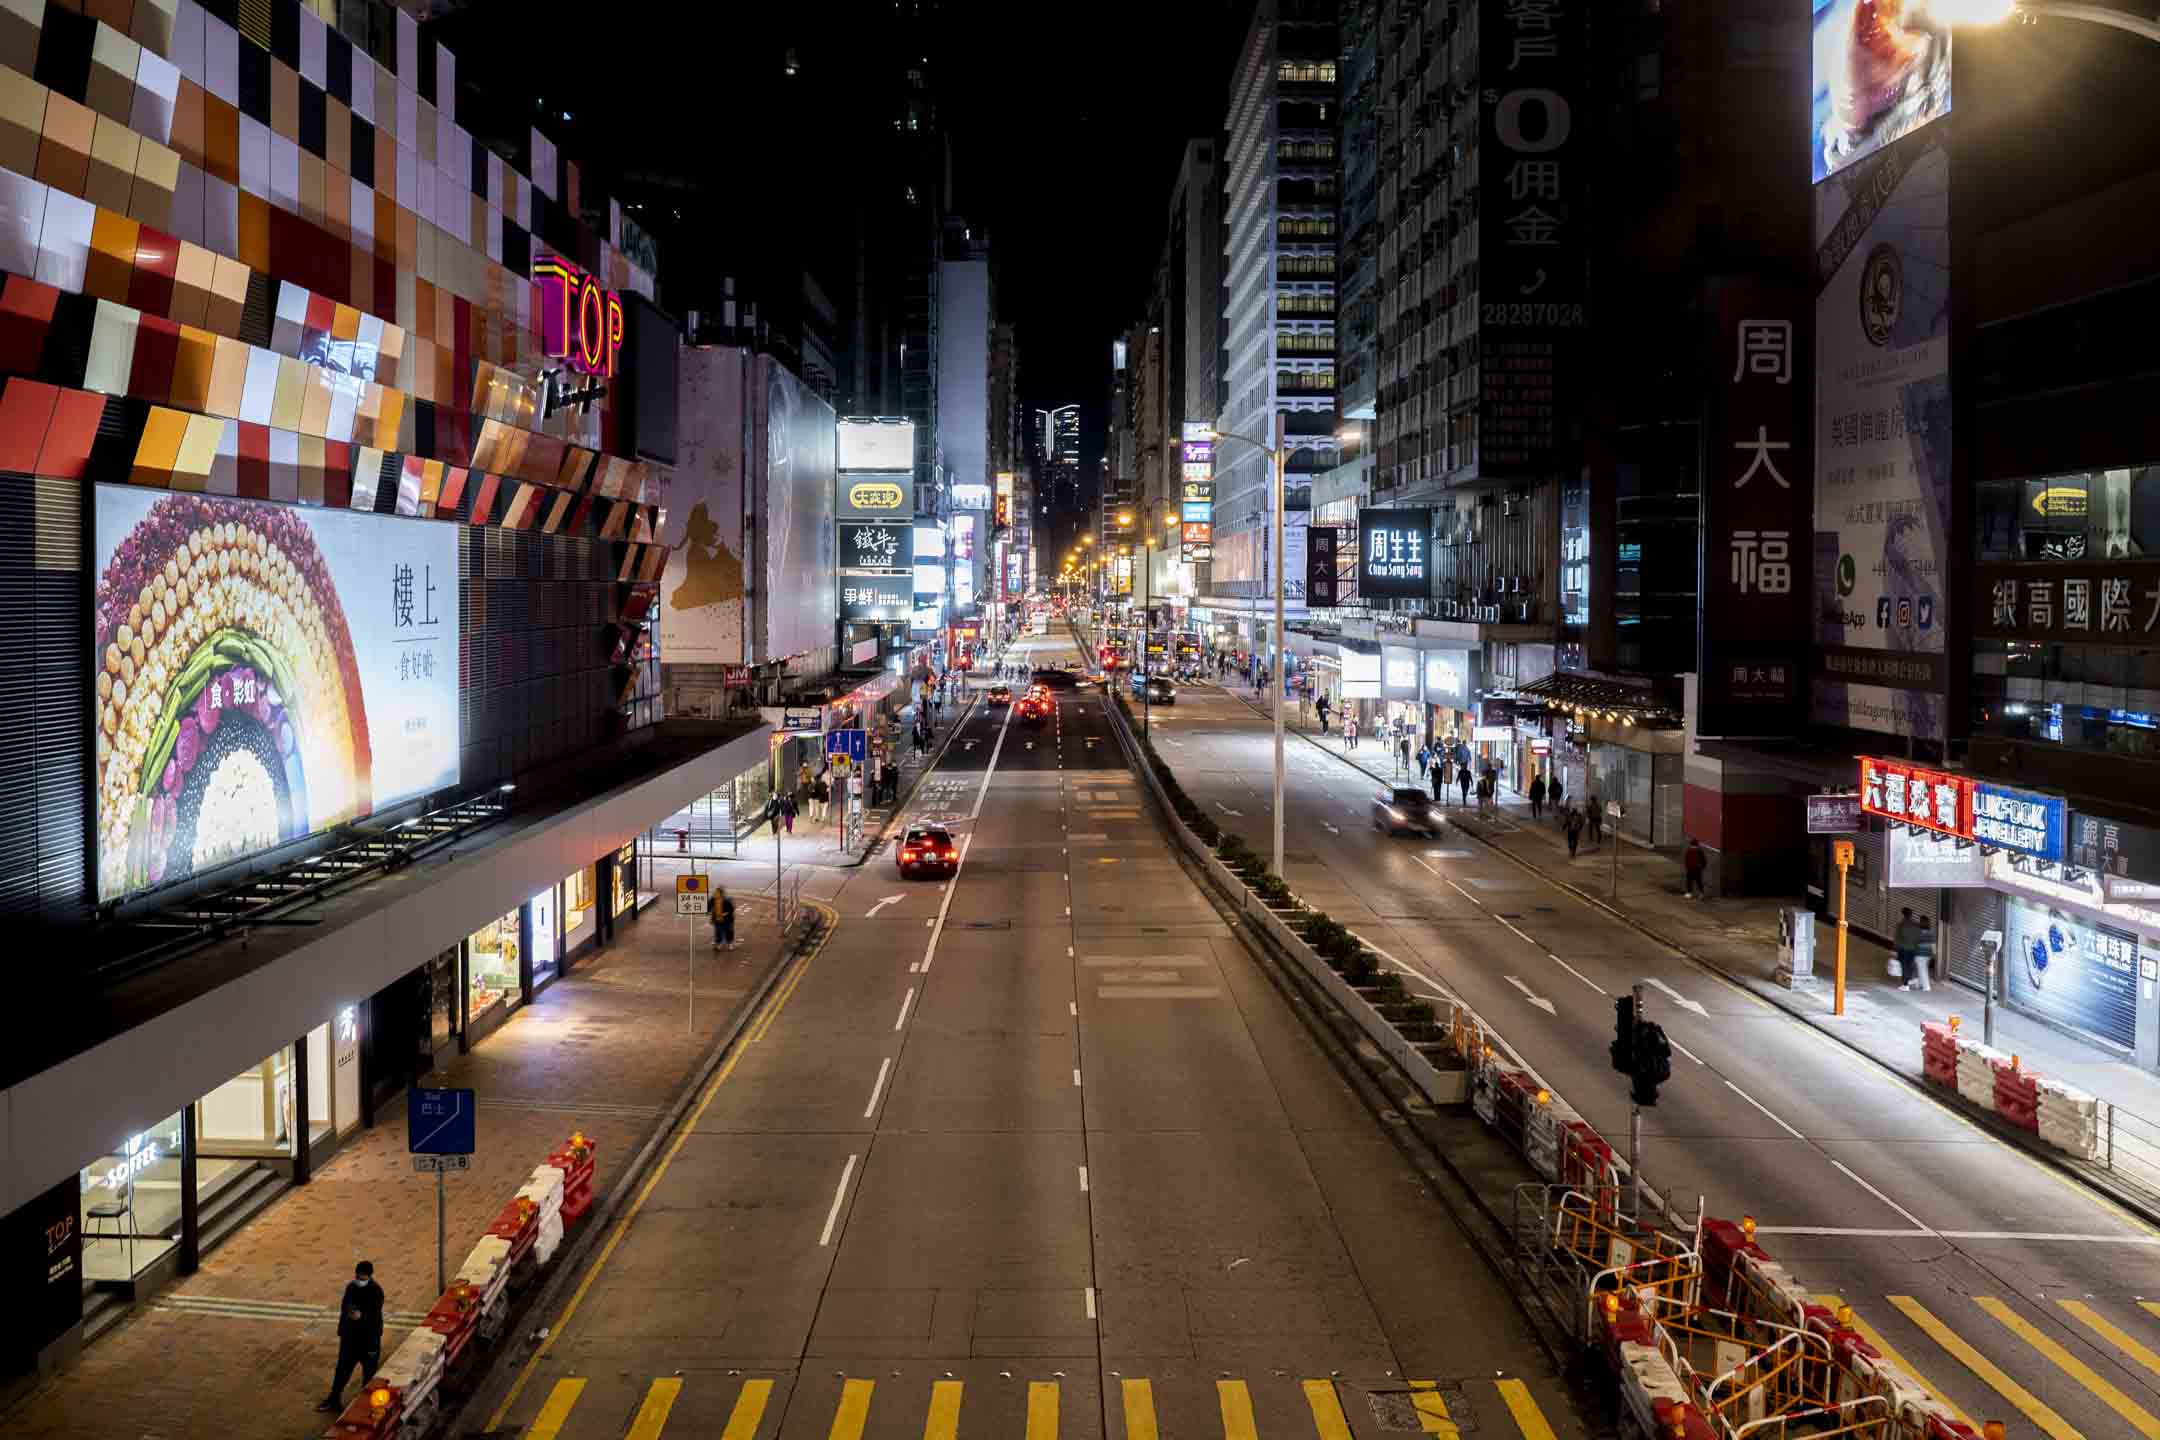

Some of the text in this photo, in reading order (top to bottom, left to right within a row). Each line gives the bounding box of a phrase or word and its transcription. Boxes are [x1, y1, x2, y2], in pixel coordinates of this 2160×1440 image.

[533, 257, 624, 379] TOP
[1731, 319, 1792, 594] 周大福
[1368, 529, 1422, 563] 周生生
[1314, 537, 1329, 597] 周大福
[1368, 564, 1422, 578] Chow Sang Sang
[392, 563, 440, 628] 樓上
[681, 901, 702, 911] 全日
[421, 1102, 446, 1115] 巴士
[47, 1216, 73, 1245] TOP
